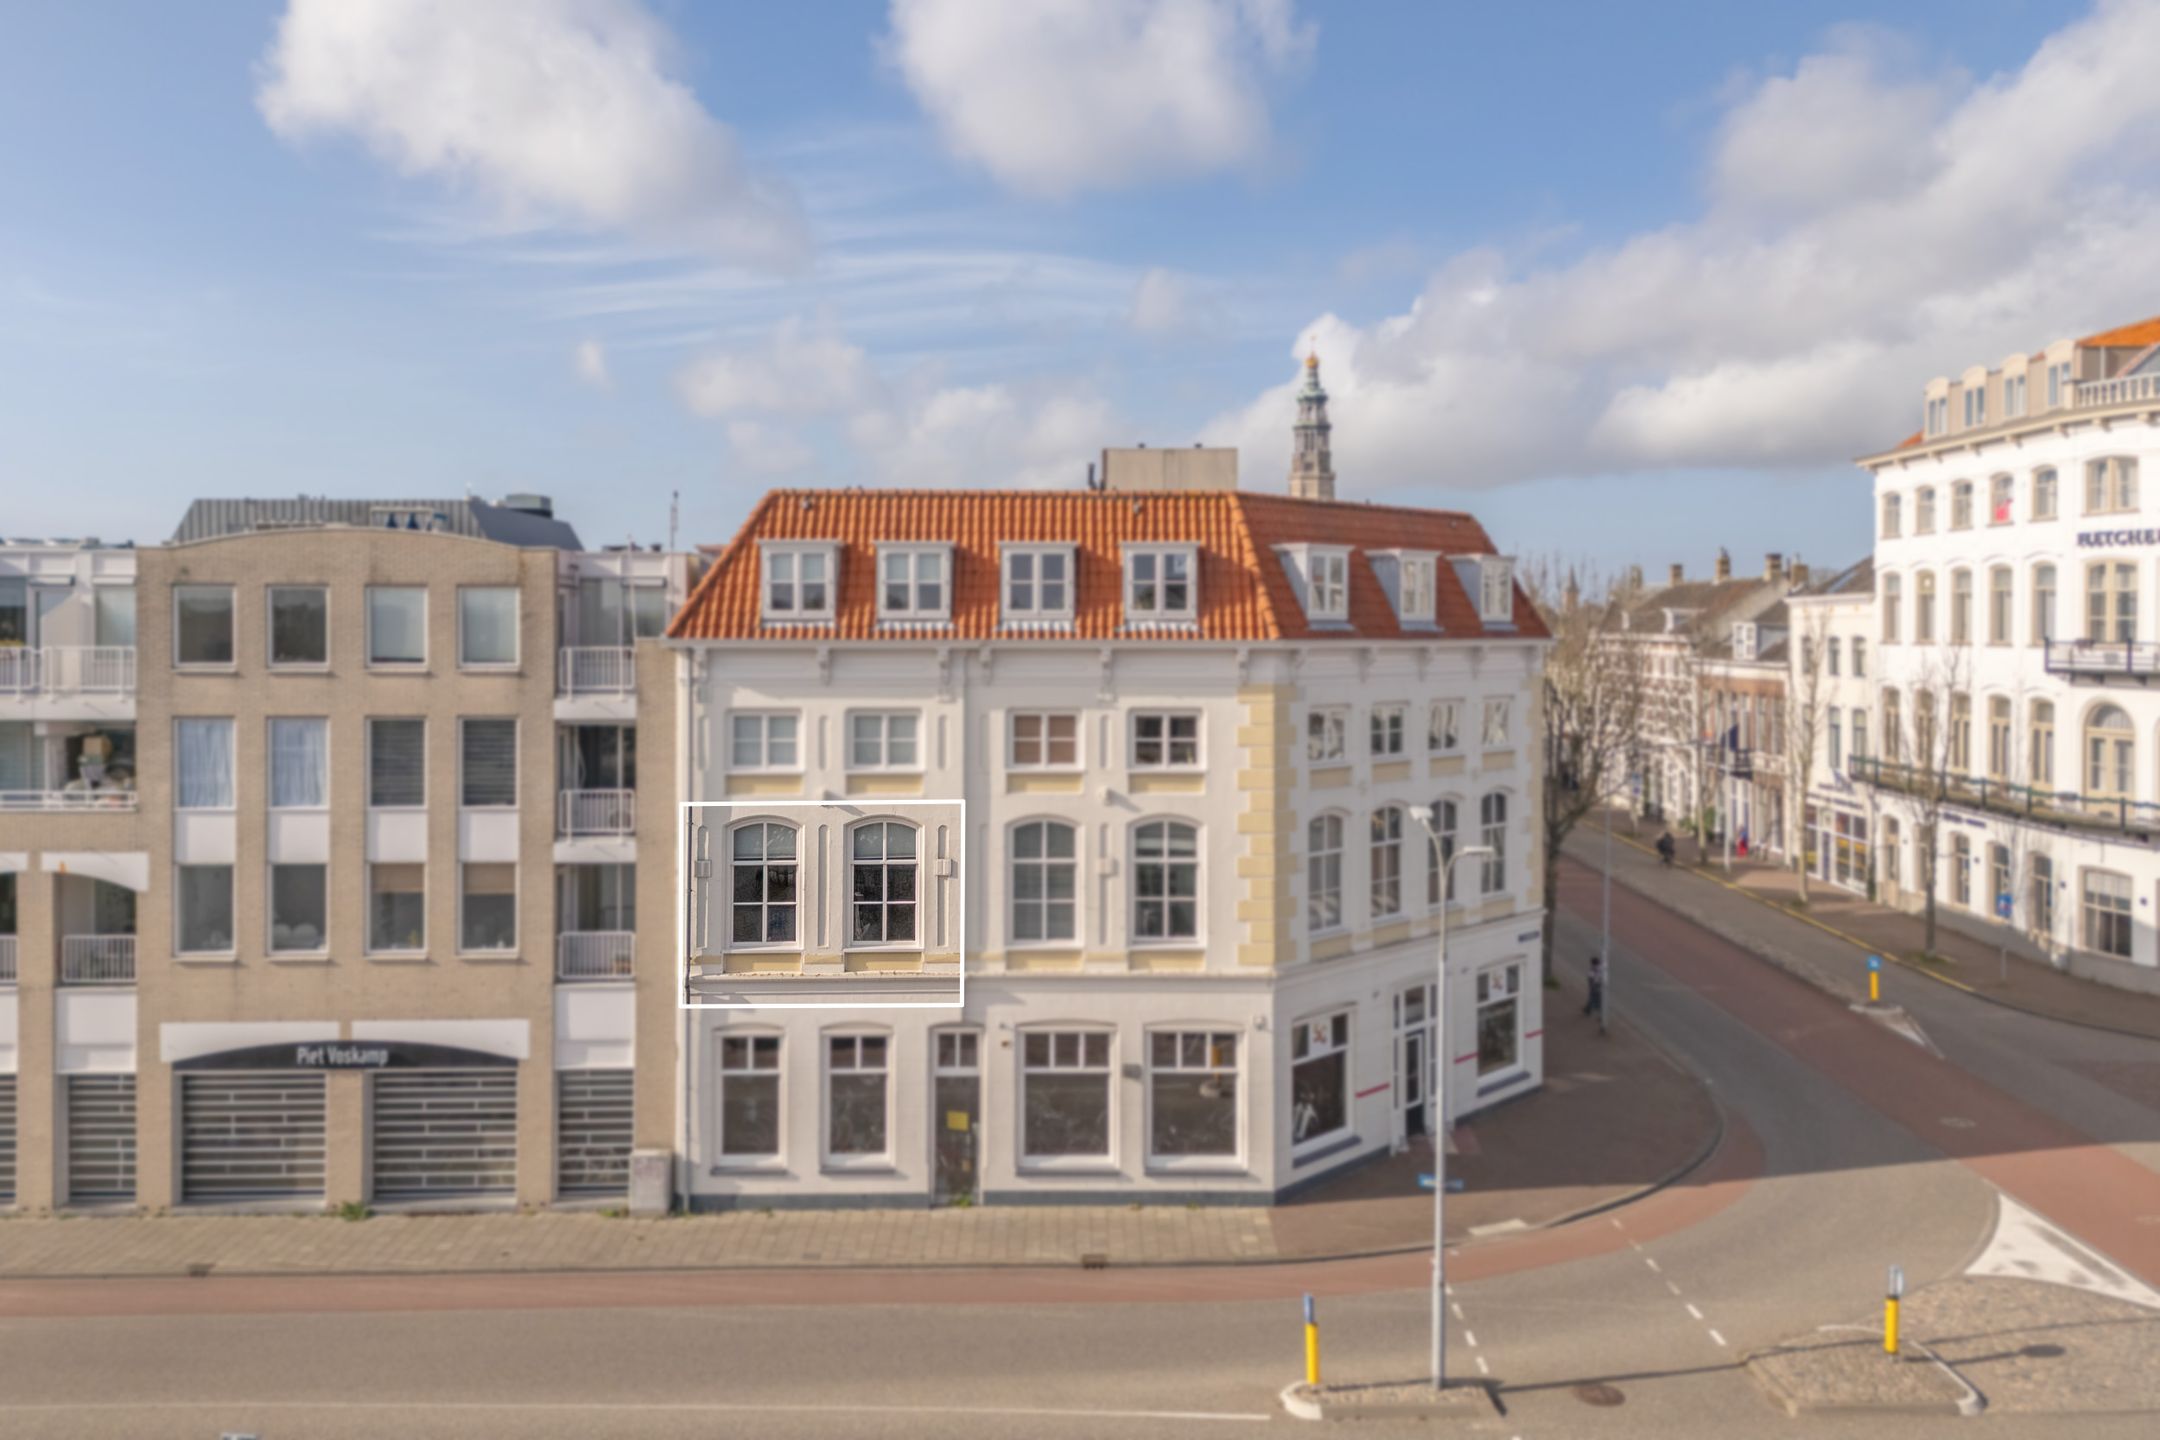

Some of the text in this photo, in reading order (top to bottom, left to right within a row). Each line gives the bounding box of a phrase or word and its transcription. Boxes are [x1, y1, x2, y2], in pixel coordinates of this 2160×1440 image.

[2077, 528, 2160, 547] FLETCHE
[297, 1046, 389, 1067] Piet Voskamp
